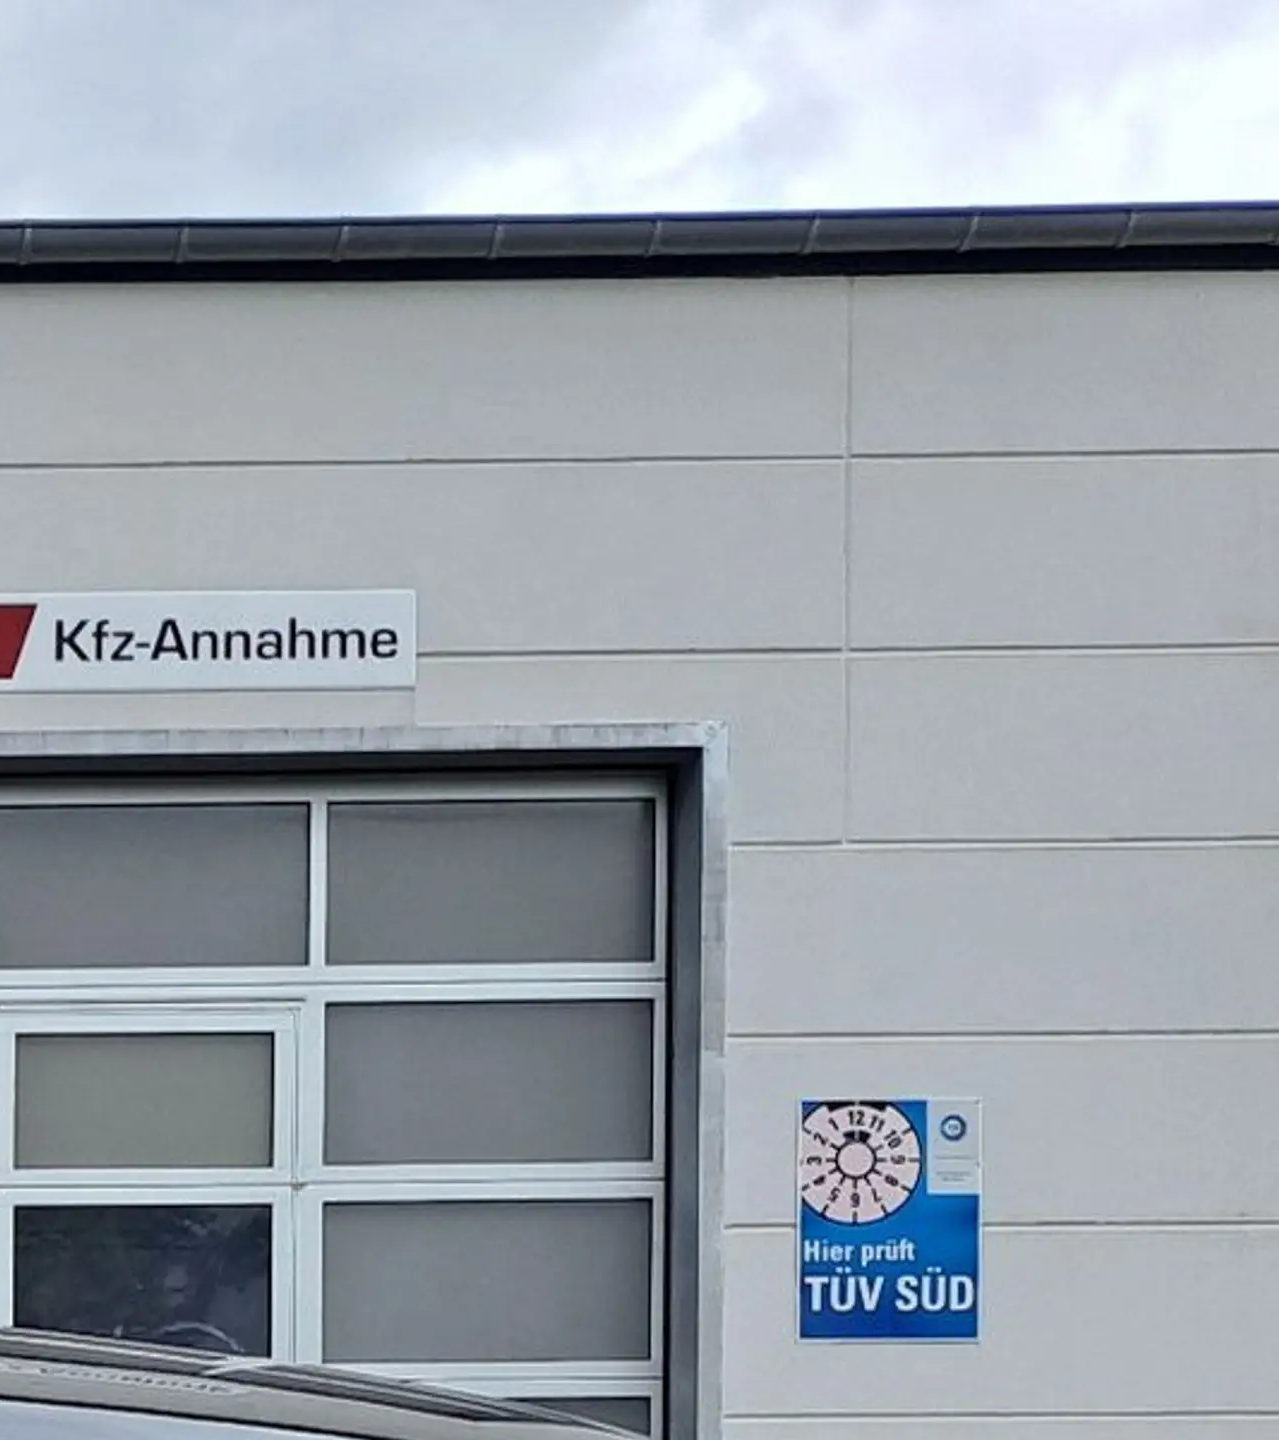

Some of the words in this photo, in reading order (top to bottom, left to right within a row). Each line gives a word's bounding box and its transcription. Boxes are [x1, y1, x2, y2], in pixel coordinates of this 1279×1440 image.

[54, 617, 398, 662] Kfz-Annahme
[828, 1117, 839, 1131] 1
[847, 1110, 865, 1126] 12
[869, 1114, 886, 1132] 11
[813, 1132, 828, 1146] 2
[884, 1130, 902, 1149] 10
[806, 1156, 822, 1165] 3
[828, 1187, 841, 1202] 5
[871, 1187, 882, 1202] 7
[803, 1239, 855, 1262] Hier
[860, 1238, 916, 1267] prüft
[804, 1266, 885, 1312] TÜV
[894, 1266, 975, 1312] SÜD
